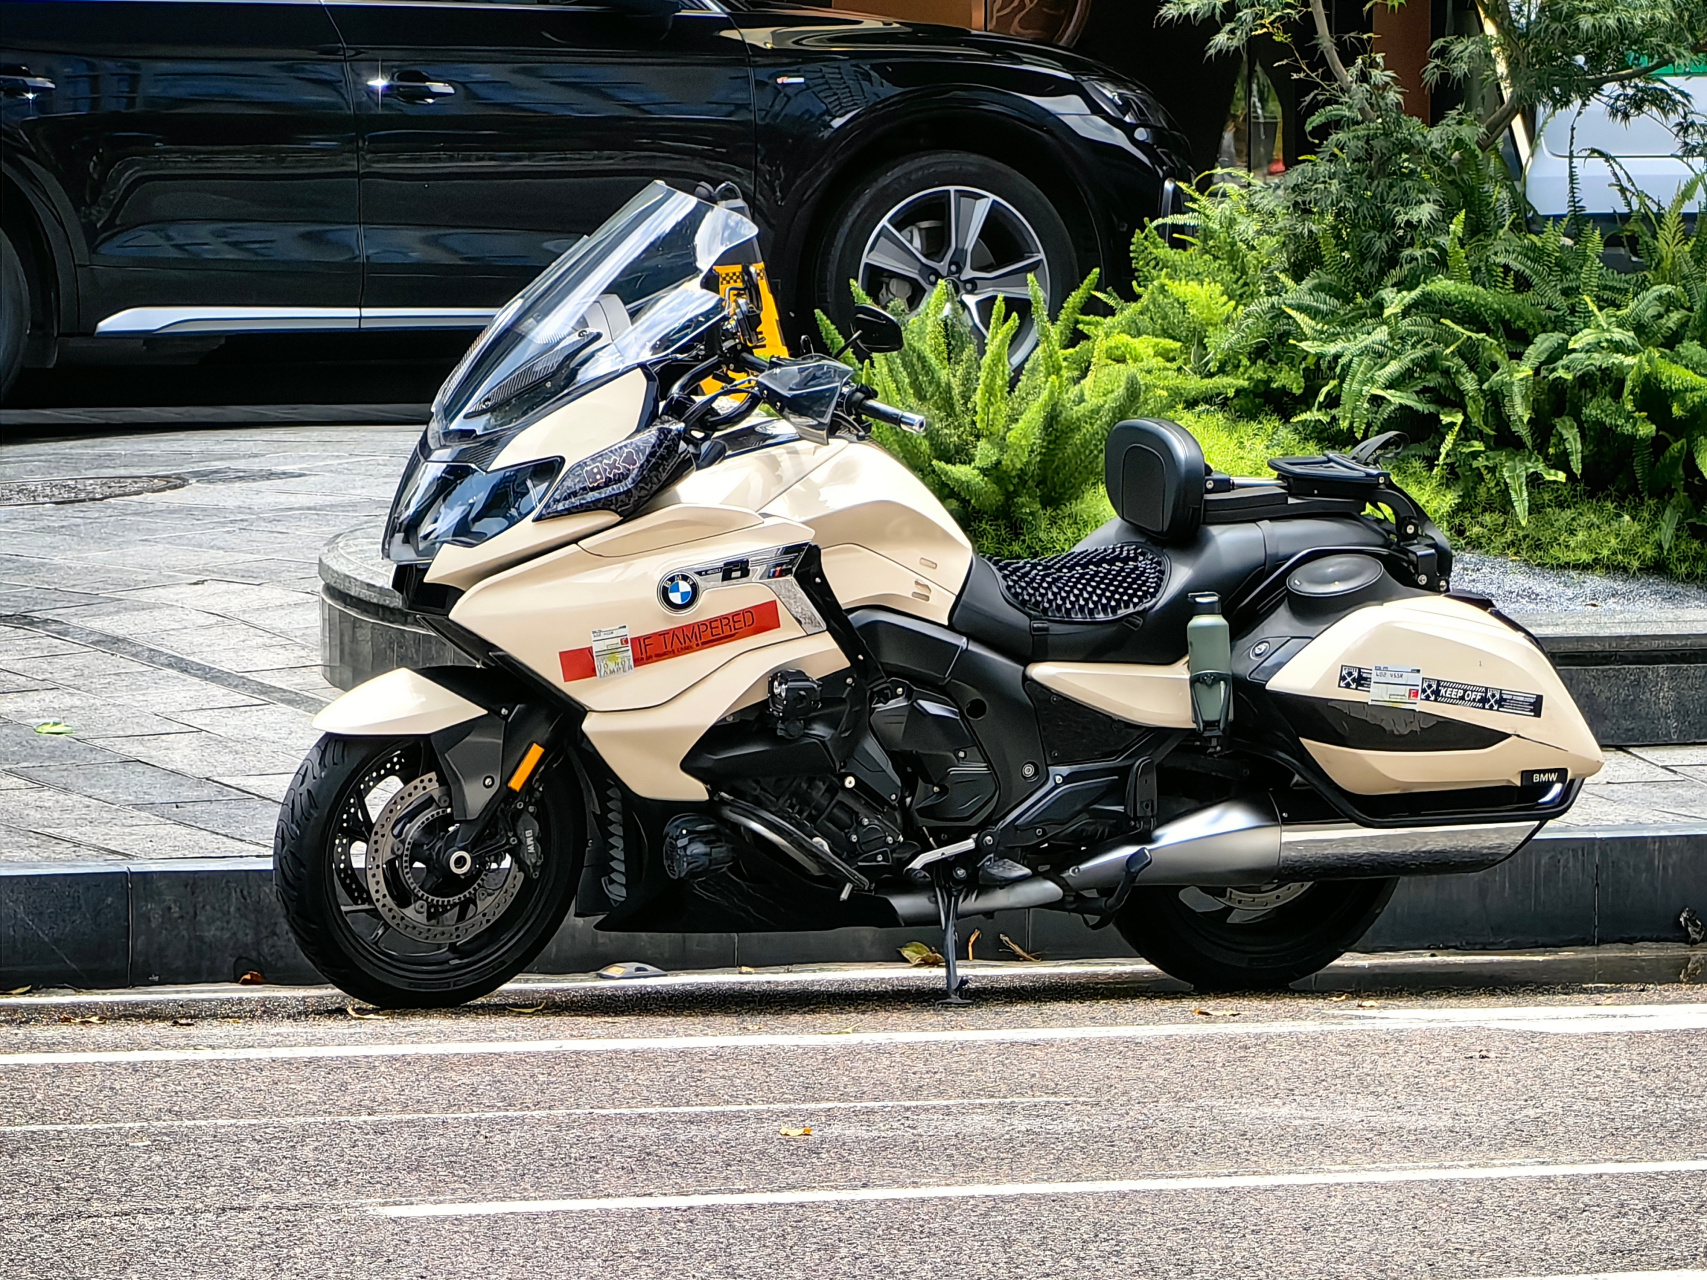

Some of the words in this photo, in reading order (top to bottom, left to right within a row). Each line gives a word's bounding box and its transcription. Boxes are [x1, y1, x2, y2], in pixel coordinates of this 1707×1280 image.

[638, 636, 653, 657] IF
[659, 610, 755, 649] TAMPERED
[1533, 772, 1558, 783] BMW
[525, 829, 536, 853] BMW
